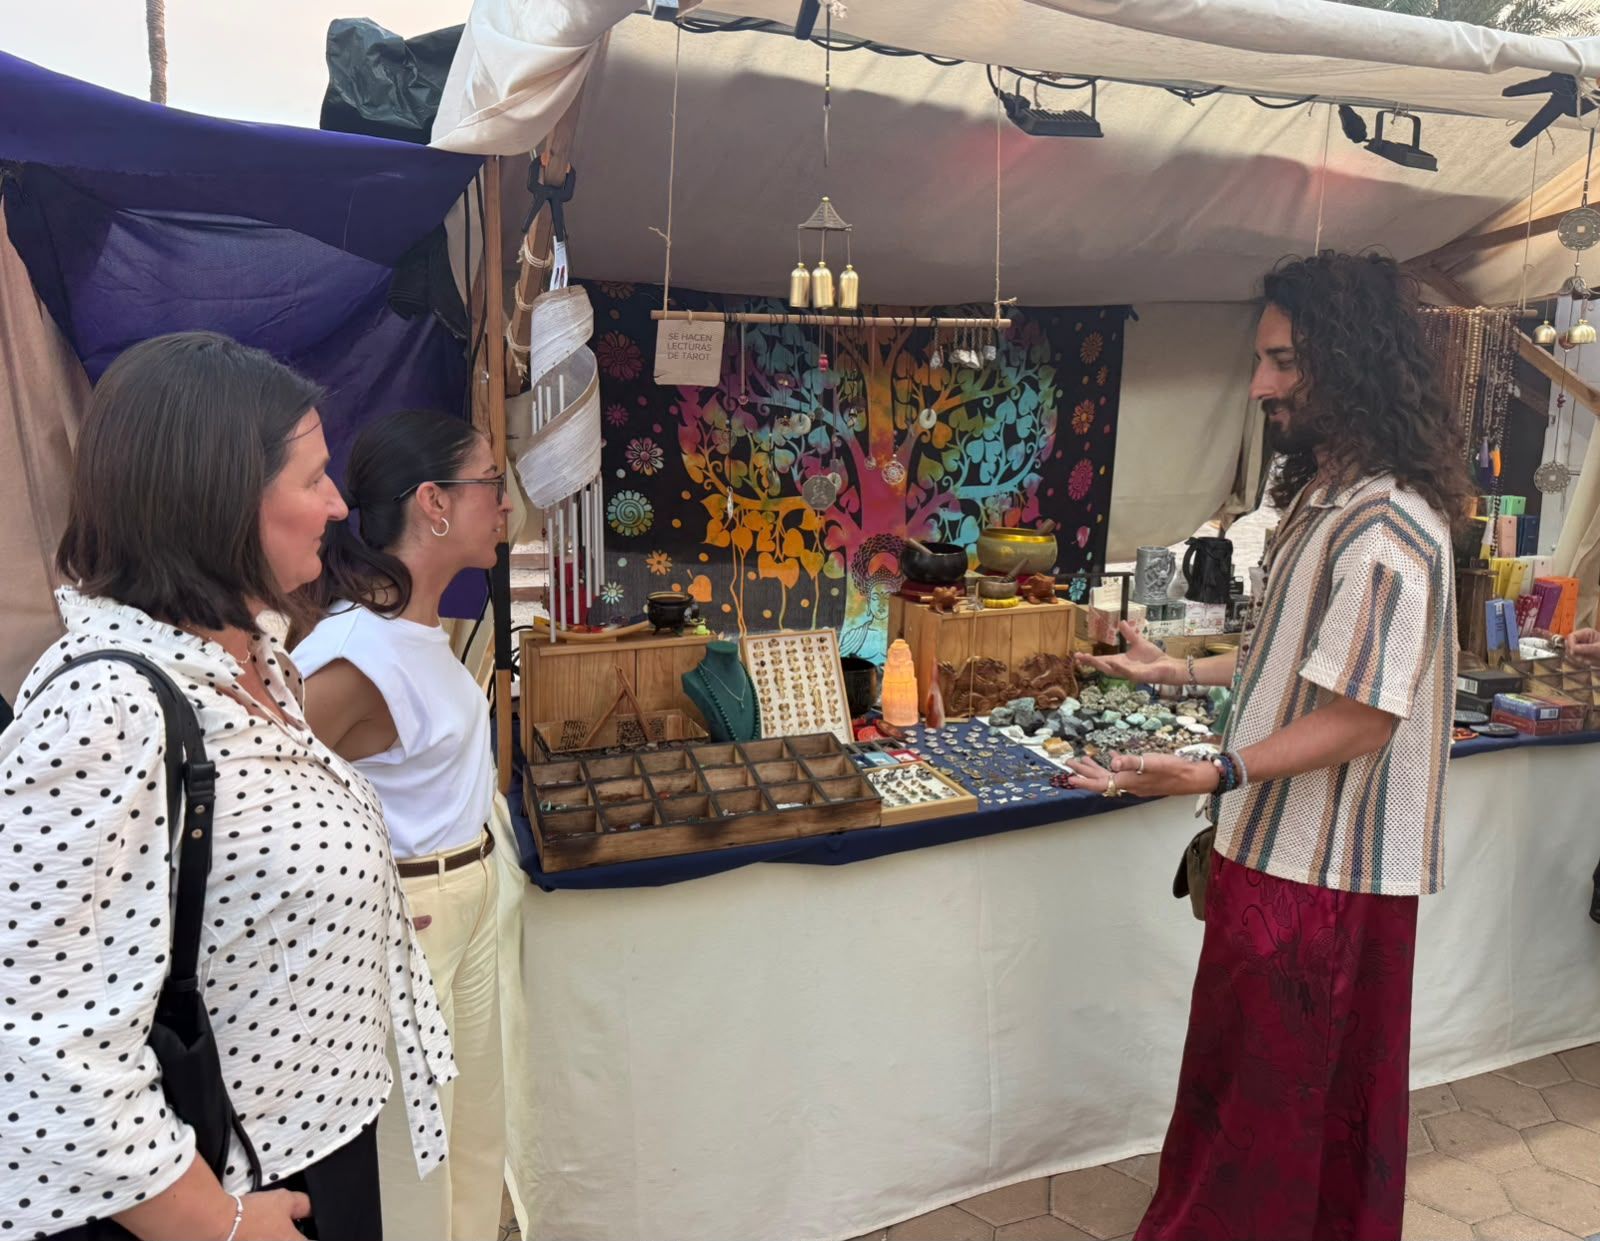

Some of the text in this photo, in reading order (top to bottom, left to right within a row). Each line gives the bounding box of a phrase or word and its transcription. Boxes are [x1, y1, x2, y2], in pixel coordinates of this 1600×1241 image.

[668, 332, 712, 342] SE HACEN
[667, 342, 713, 351] LECTURAS
[667, 352, 711, 361] DE TAROT
